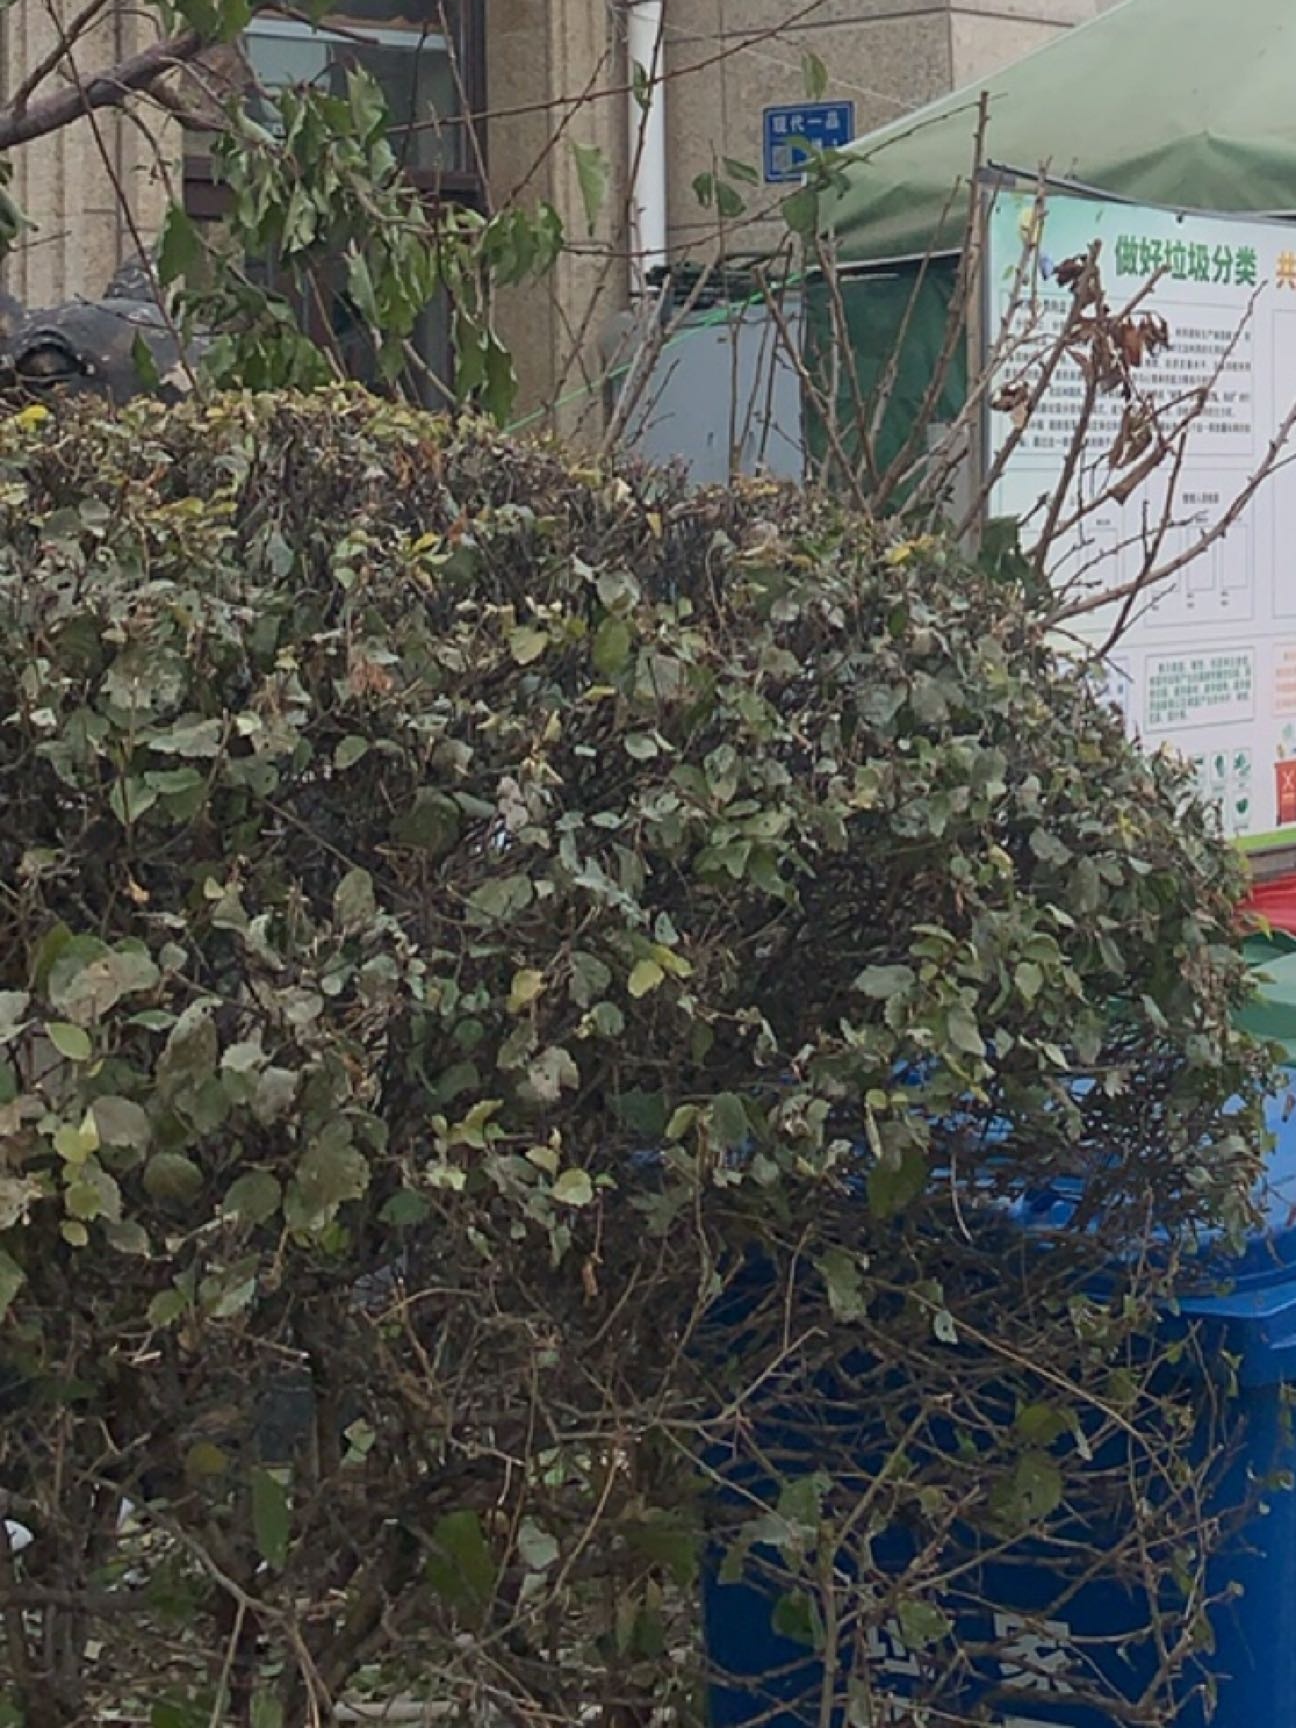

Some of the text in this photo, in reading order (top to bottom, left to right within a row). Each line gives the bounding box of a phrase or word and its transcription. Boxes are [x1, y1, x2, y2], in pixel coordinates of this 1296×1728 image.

[1115, 234, 1257, 286] 做好垃圾分类
